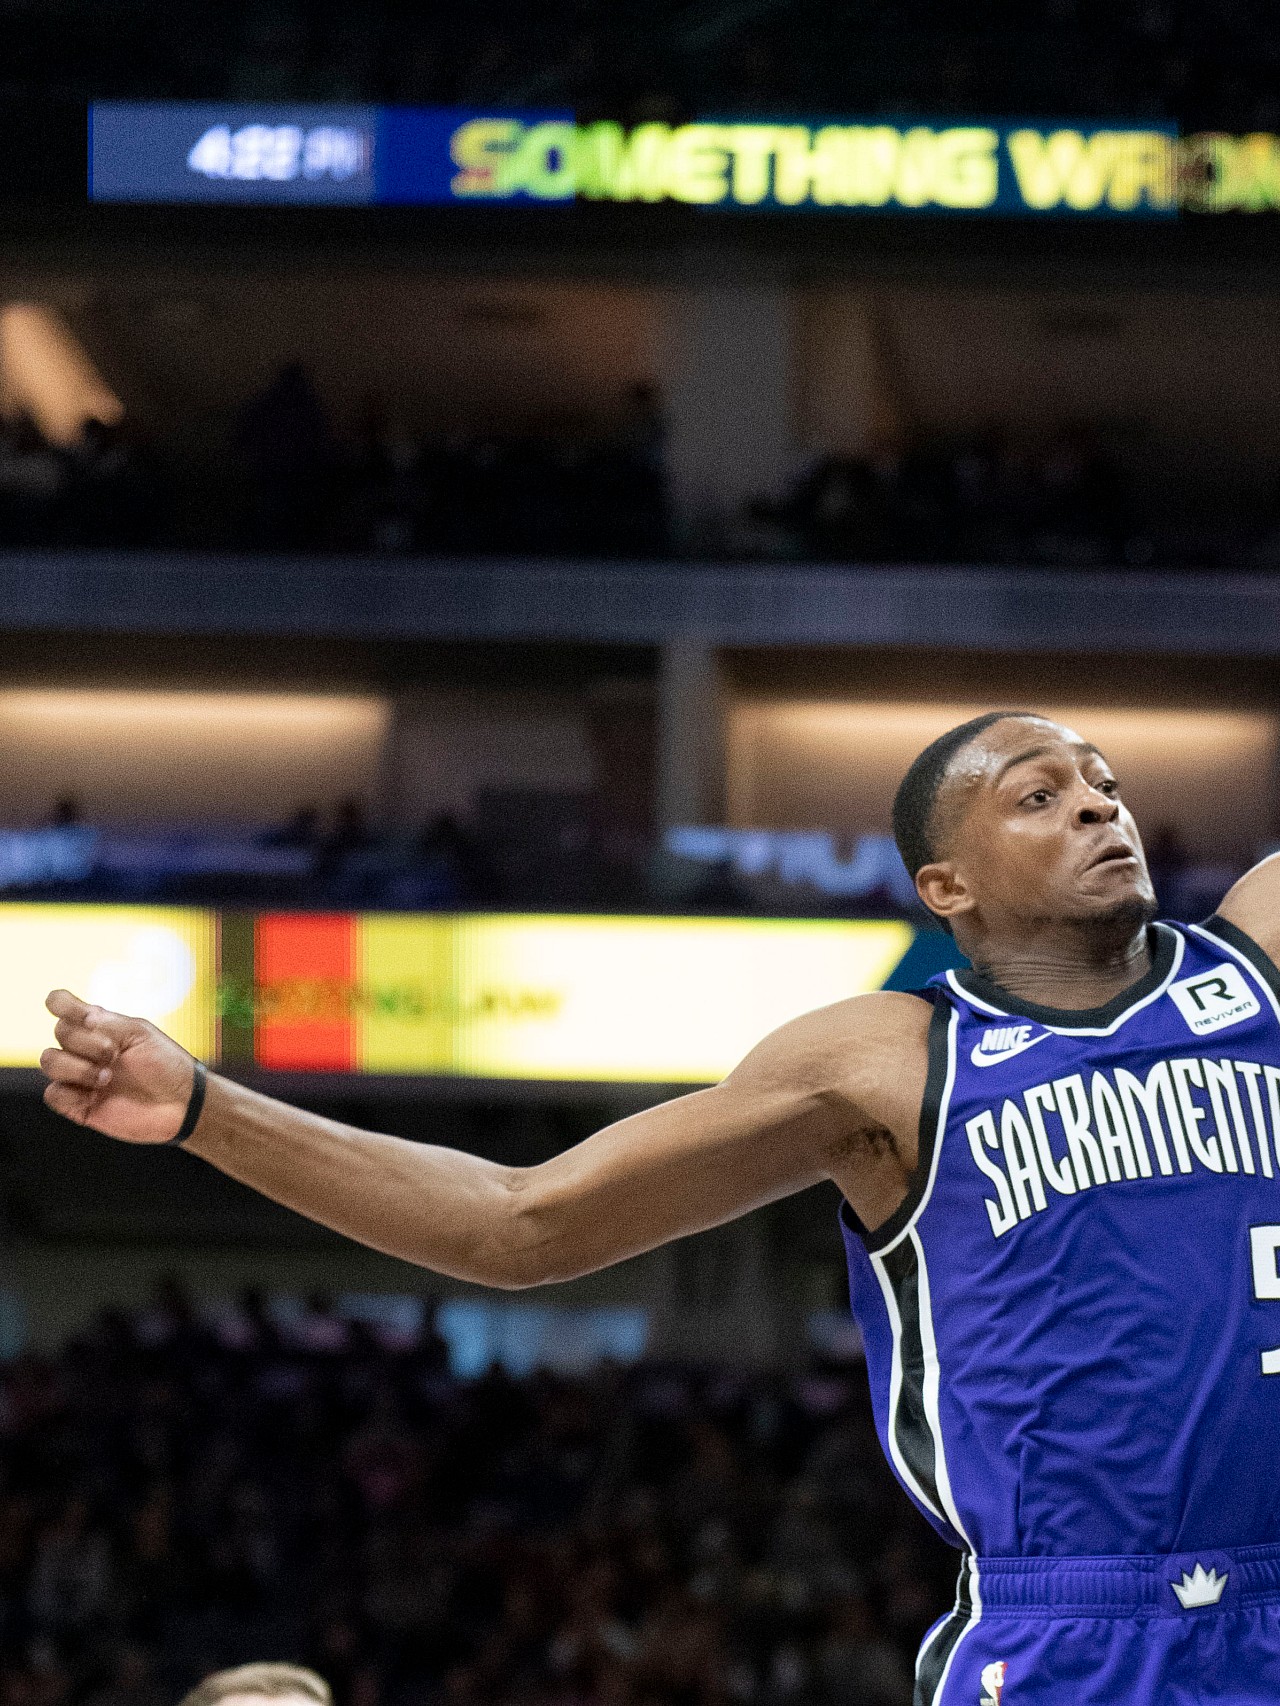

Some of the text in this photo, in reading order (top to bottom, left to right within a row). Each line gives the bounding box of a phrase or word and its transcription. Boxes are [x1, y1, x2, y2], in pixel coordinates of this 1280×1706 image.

[450, 117, 1000, 208] SOMETHING
[1194, 1001, 1252, 1028] REVIVER
[980, 1025, 1033, 1052] NIKE
